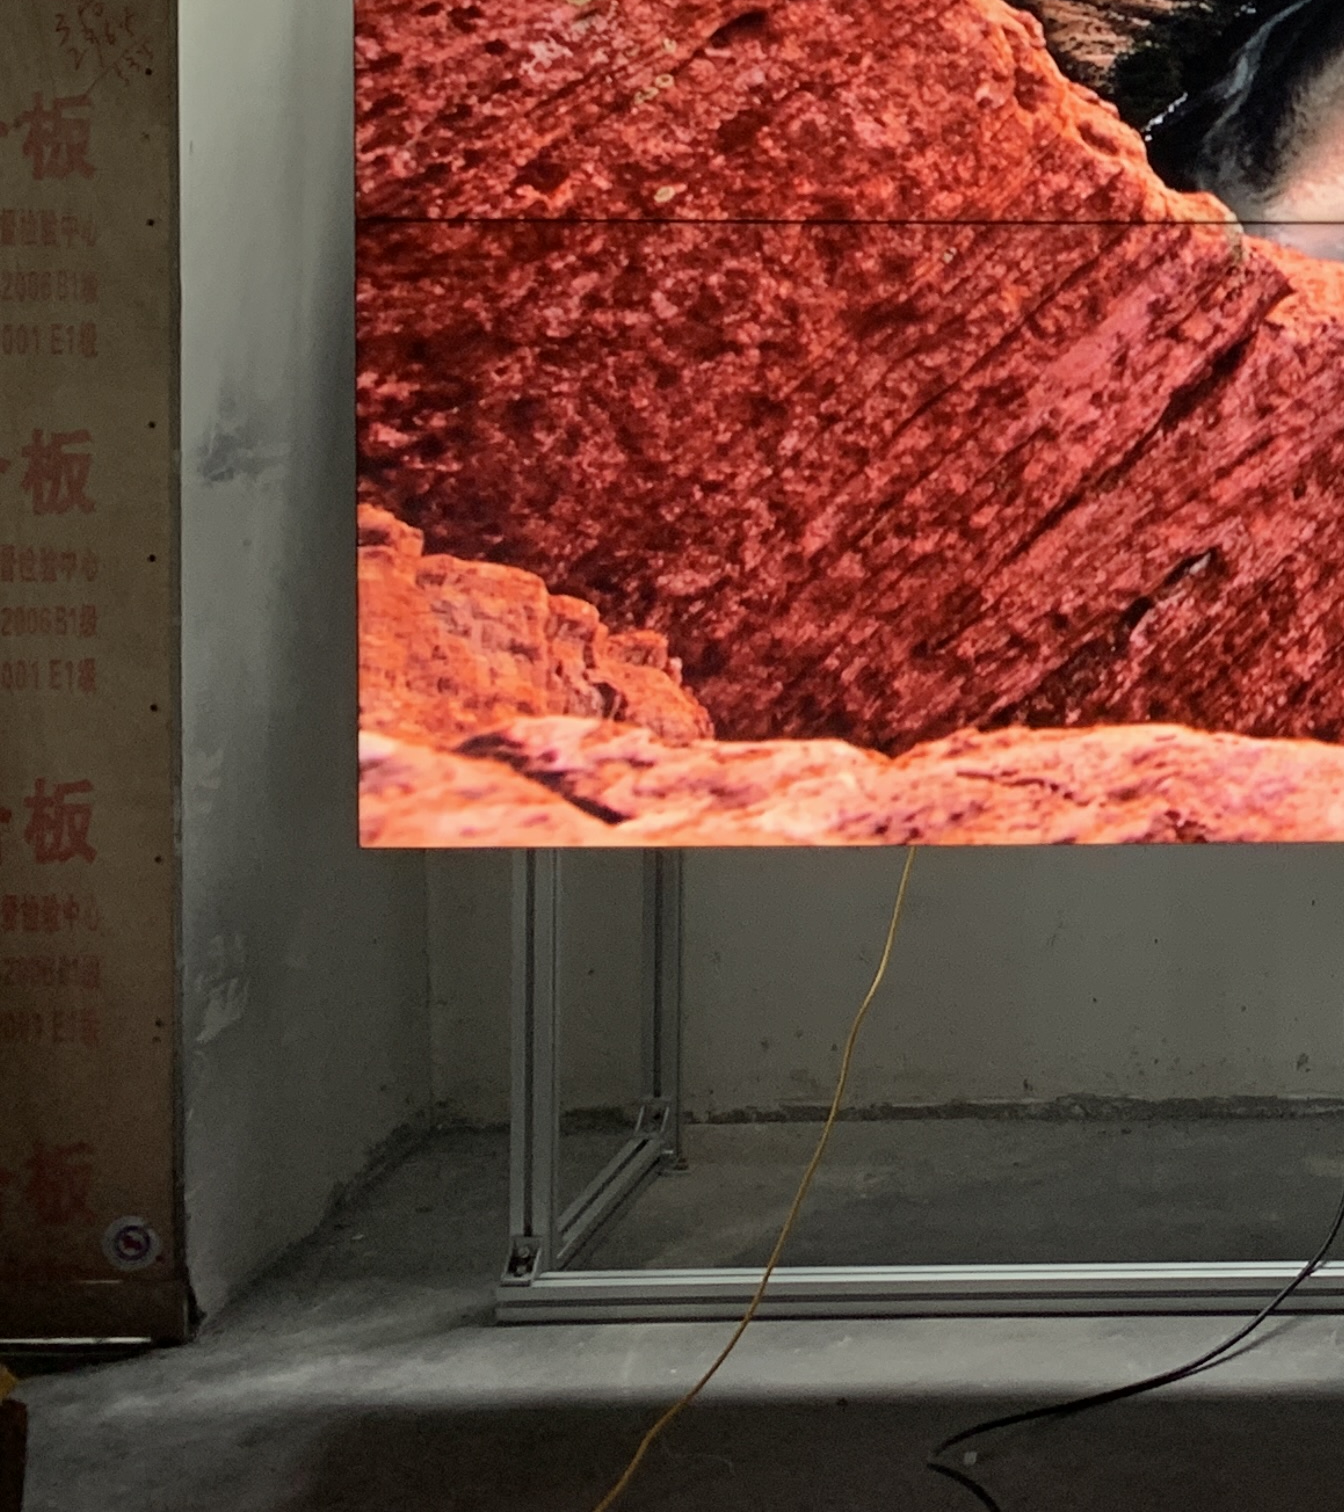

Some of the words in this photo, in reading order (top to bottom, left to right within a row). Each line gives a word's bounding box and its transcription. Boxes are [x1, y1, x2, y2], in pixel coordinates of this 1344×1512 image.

[22, 90, 97, 180] 板
[21, 428, 96, 516] 板
[24, 777, 98, 864] 板
